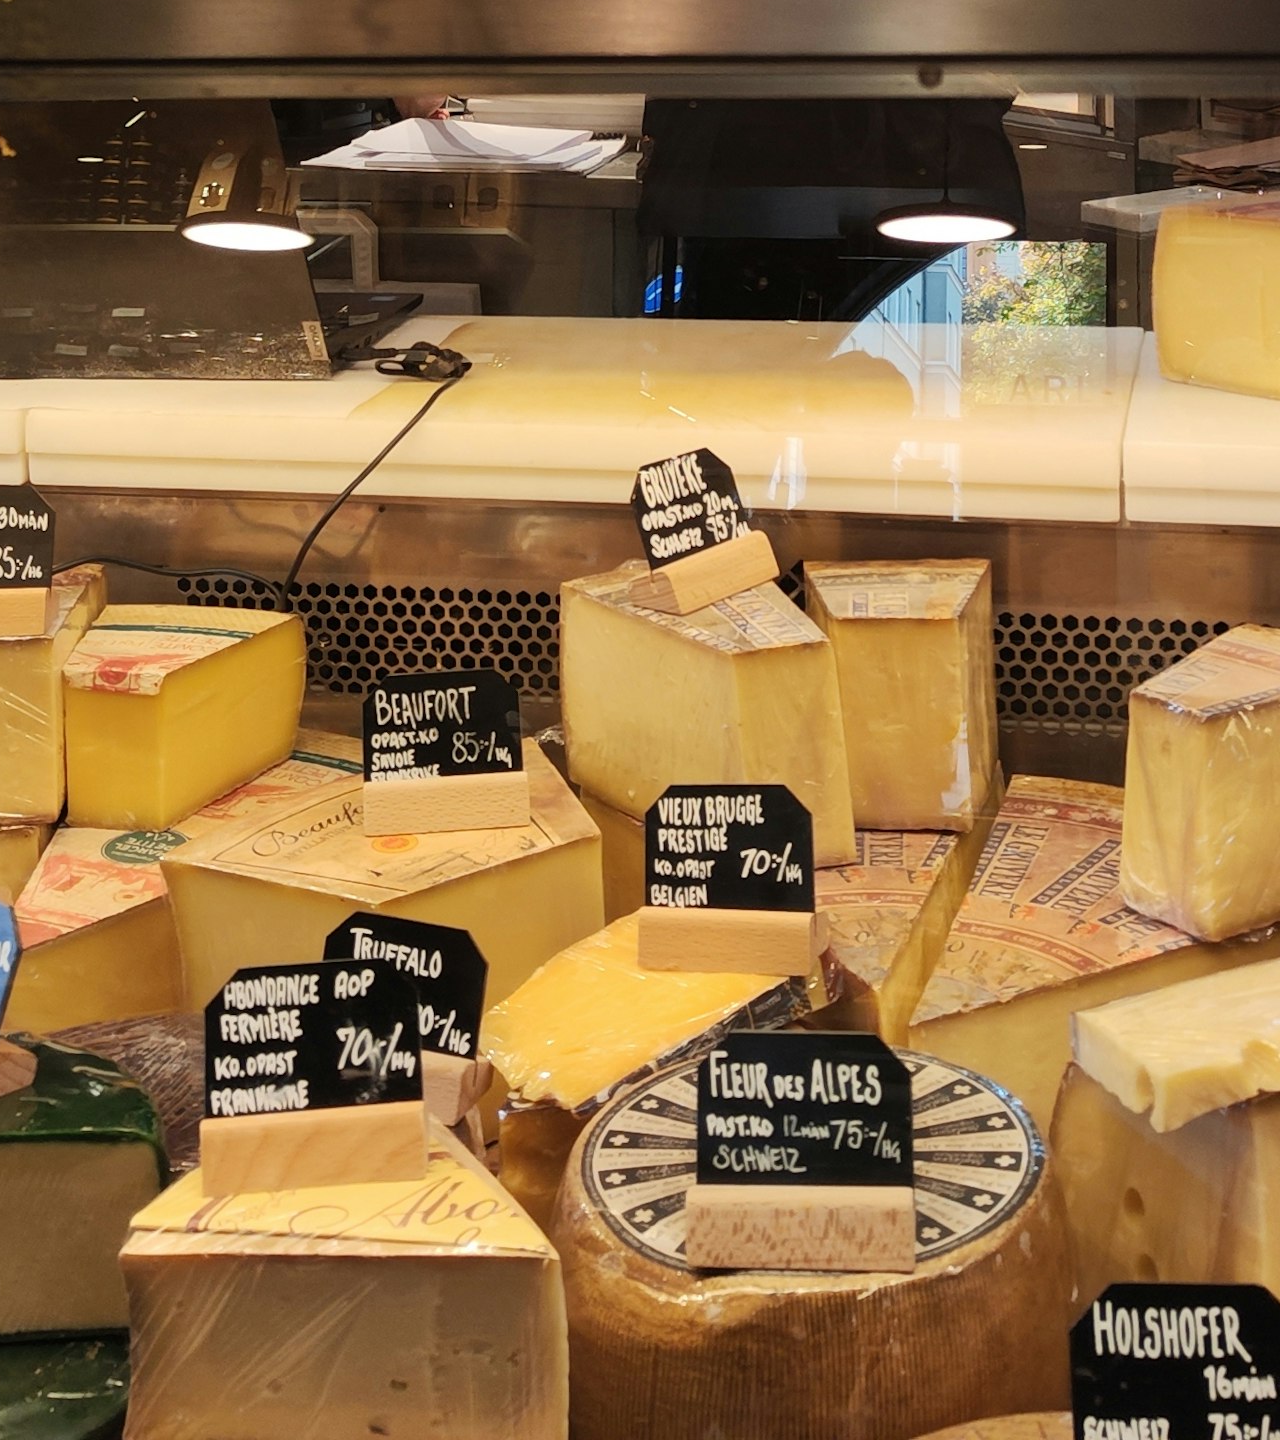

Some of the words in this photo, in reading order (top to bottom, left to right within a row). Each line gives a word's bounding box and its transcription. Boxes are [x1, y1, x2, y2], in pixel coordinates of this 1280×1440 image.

[374, 686, 478, 728] BEAUFORT
[371, 750, 416, 772] SAVOIE
[658, 797, 702, 826] VIEUX
[704, 794, 765, 828] BRUGGE
[658, 827, 728, 854] PRESTIGE
[651, 884, 708, 908] BELGIEN
[350, 927, 442, 979] TRUFFALO
[334, 969, 375, 1000] AOP
[709, 1050, 774, 1108] FLEUR
[773, 1074, 804, 1101] DES
[810, 1059, 882, 1105] ALPES
[713, 1144, 807, 1173] SCHWEIZ
[1093, 1300, 1252, 1363] HOLSHOFER
